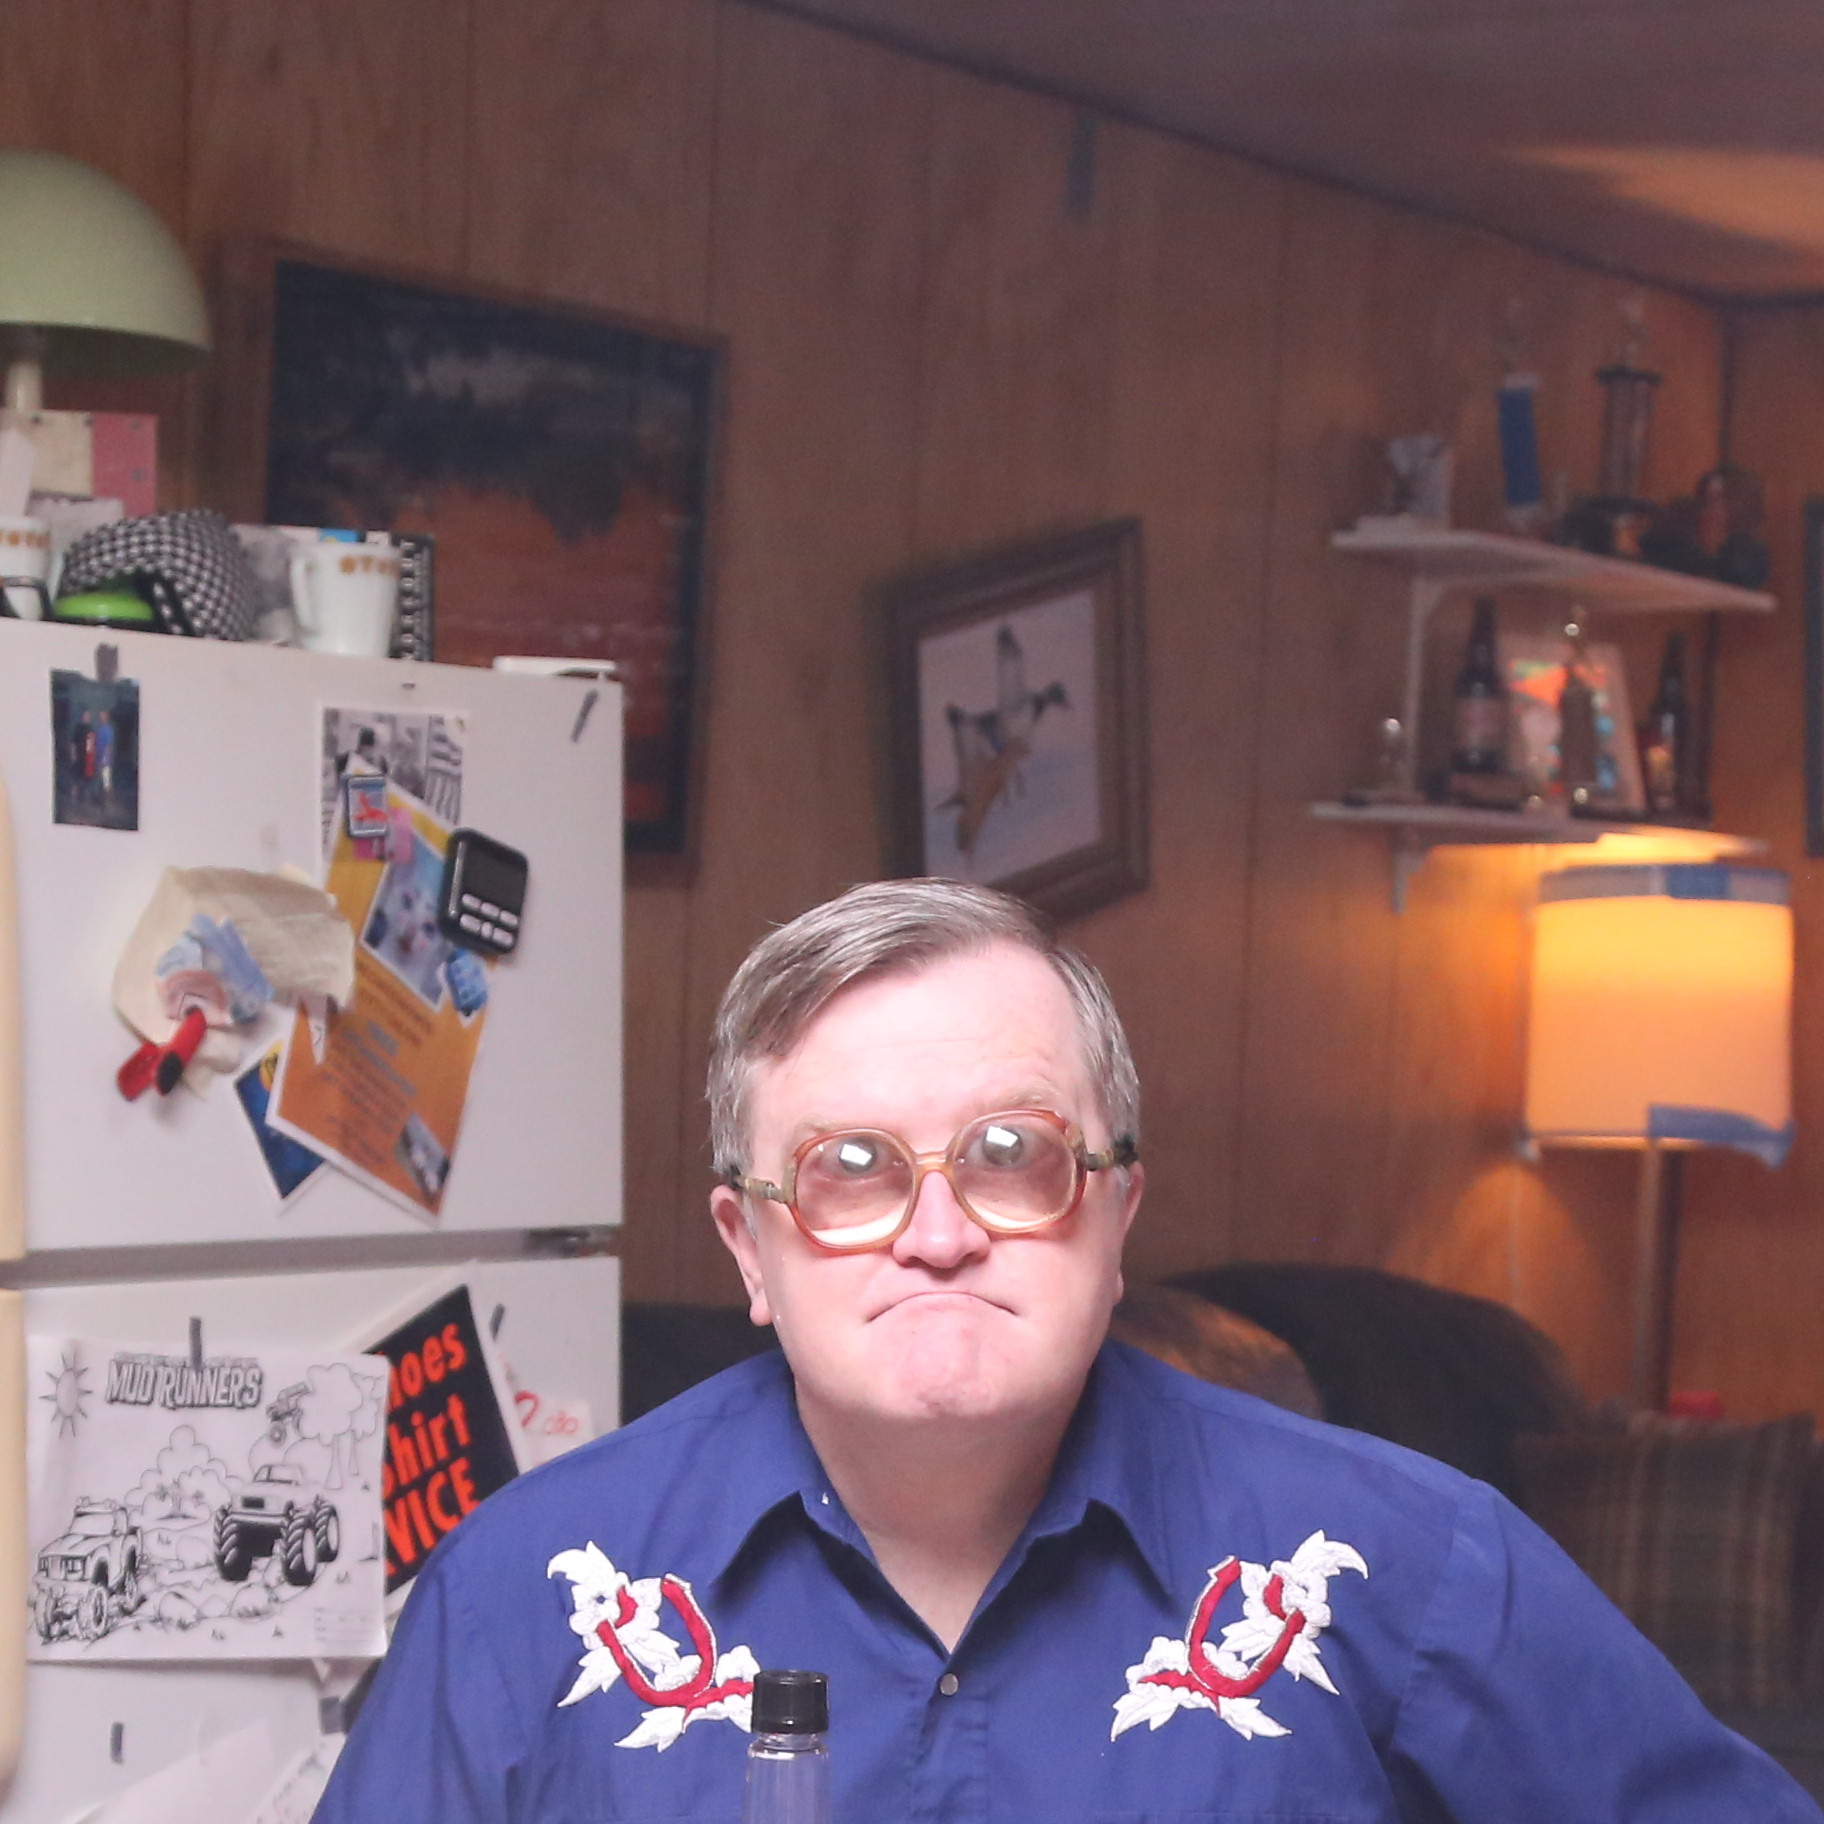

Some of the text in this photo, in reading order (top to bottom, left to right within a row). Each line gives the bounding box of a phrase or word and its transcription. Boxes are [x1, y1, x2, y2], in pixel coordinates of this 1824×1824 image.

[105, 1359, 264, 1410] MUD RUNNERS
[387, 1323, 466, 1408] oes
[384, 1457, 481, 1576] VICE
